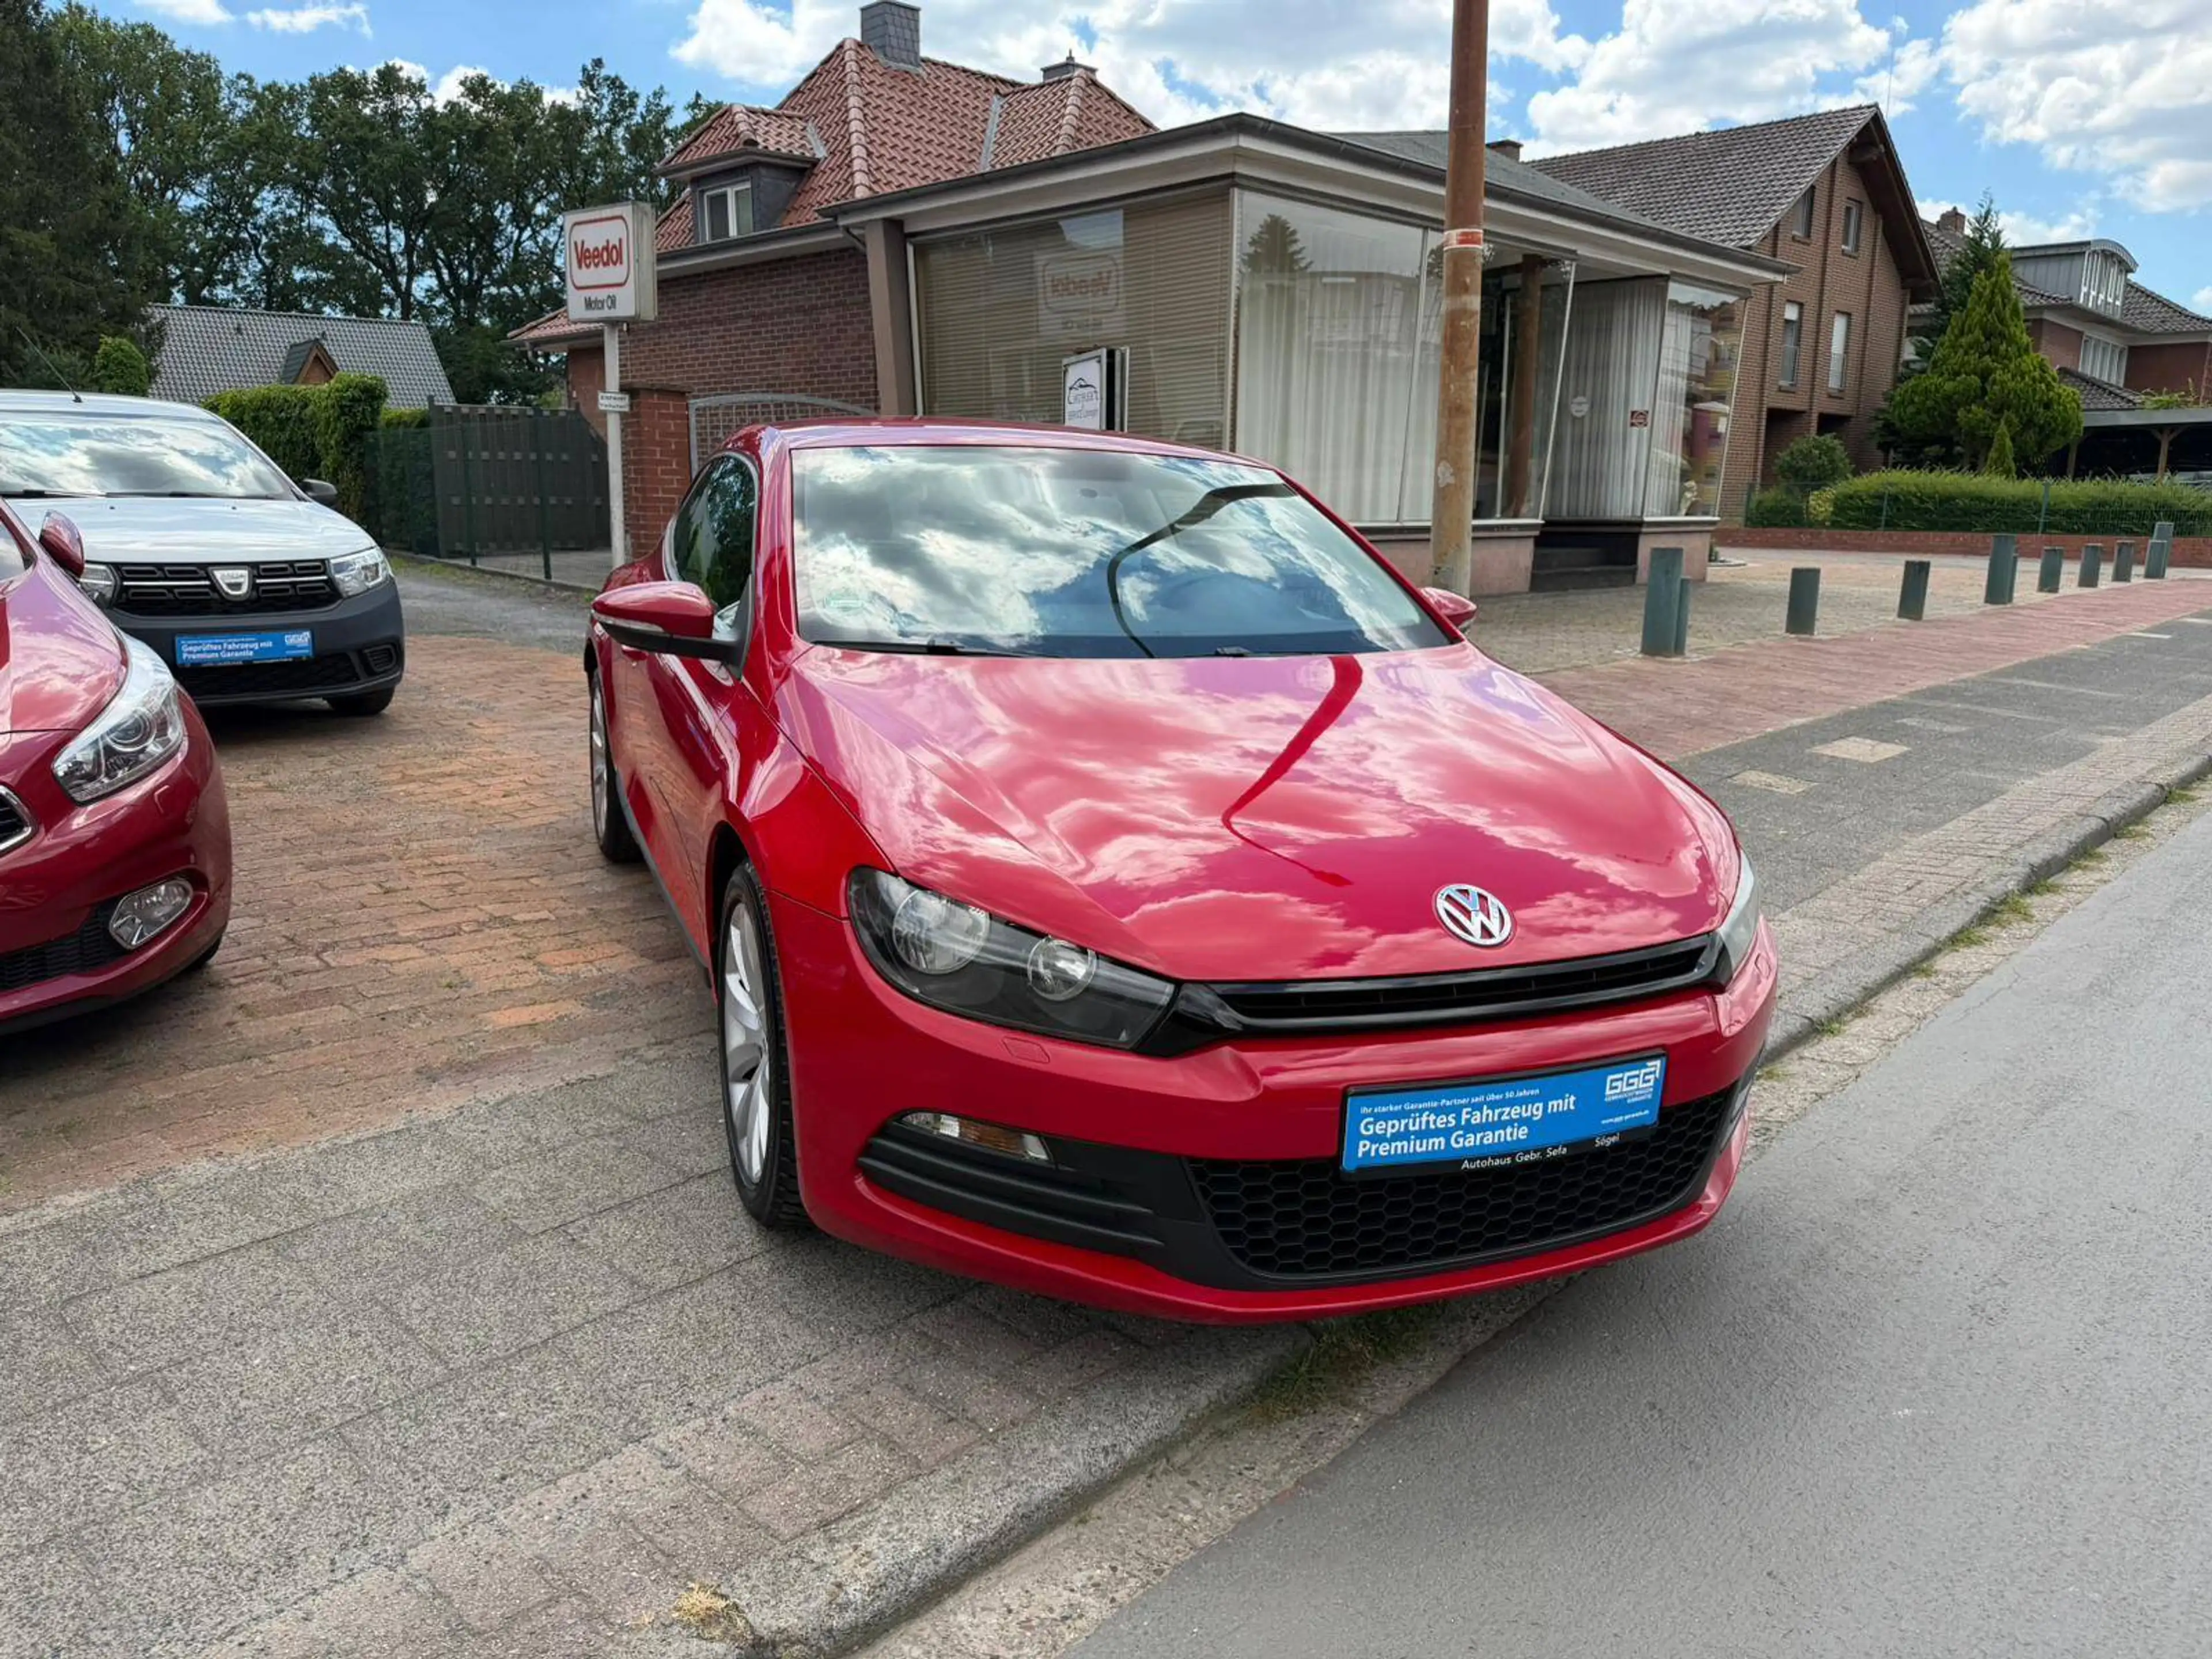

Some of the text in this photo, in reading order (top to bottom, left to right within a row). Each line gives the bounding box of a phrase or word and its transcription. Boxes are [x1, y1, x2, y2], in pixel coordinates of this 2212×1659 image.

[574, 237, 623, 270] Veedol
[584, 293, 616, 310] Motor Oil
[1605, 1066, 1656, 1095] GGG
[1359, 1111, 1456, 1138] Geprüftes
[1461, 1101, 1544, 1125] Fahrzeug
[1547, 1093, 1577, 1113] mit
[1360, 1105, 1372, 1114] Ihr
[1373, 1103, 1402, 1113] starker
[1403, 1097, 1469, 1111] Garantie-Partner
[1471, 1096, 1484, 1104] seit
[1486, 1092, 1503, 1101] über
[1515, 1087, 1540, 1097] Jahren
[1357, 1123, 1529, 1158] Premium Garantie
[1461, 1156, 1512, 1170] Autohaus
[1546, 1145, 1567, 1158] Sefa
[1594, 1132, 1620, 1147] Sögel
